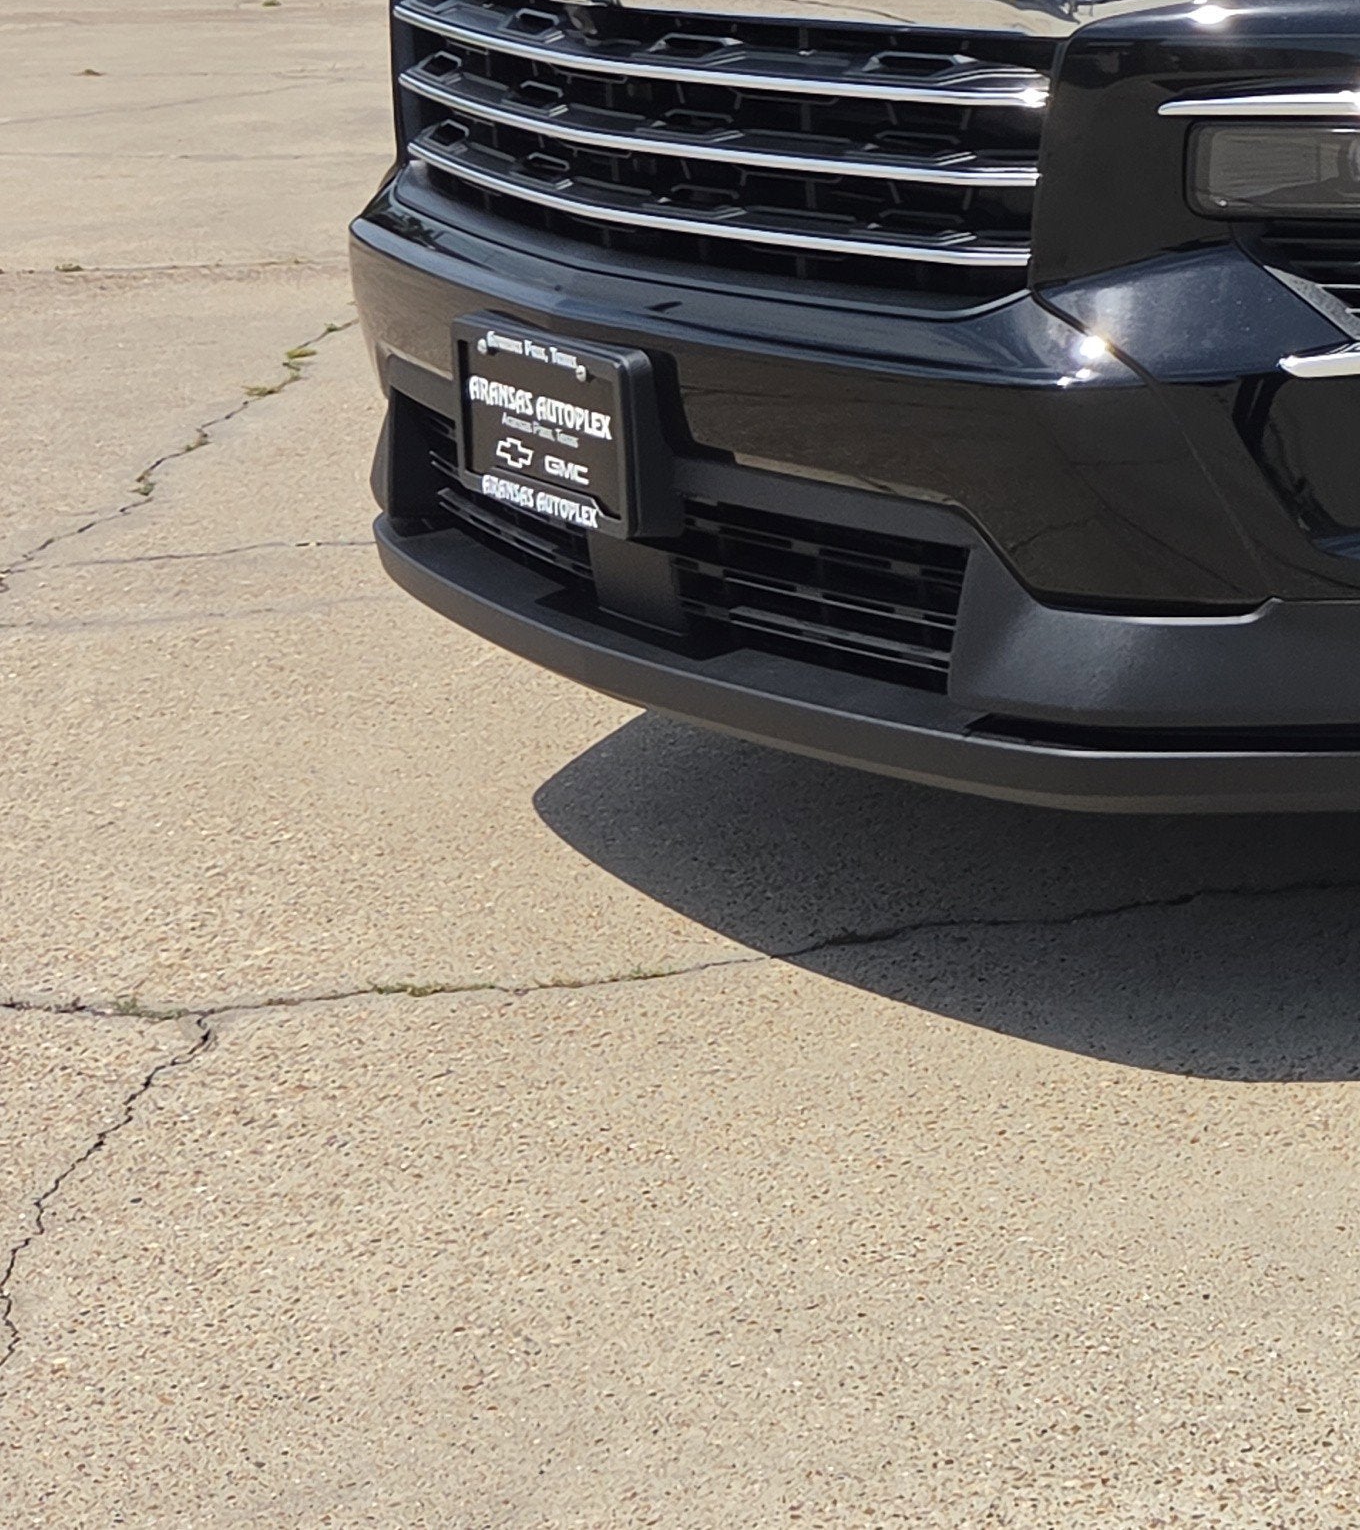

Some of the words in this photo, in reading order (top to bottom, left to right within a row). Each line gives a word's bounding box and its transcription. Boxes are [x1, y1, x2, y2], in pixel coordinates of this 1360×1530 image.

[469, 375, 534, 415] ARANSAS
[535, 396, 613, 440] AUTOPLEX
[544, 455, 590, 486] GMC
[535, 491, 598, 529] AUTOPLEX
